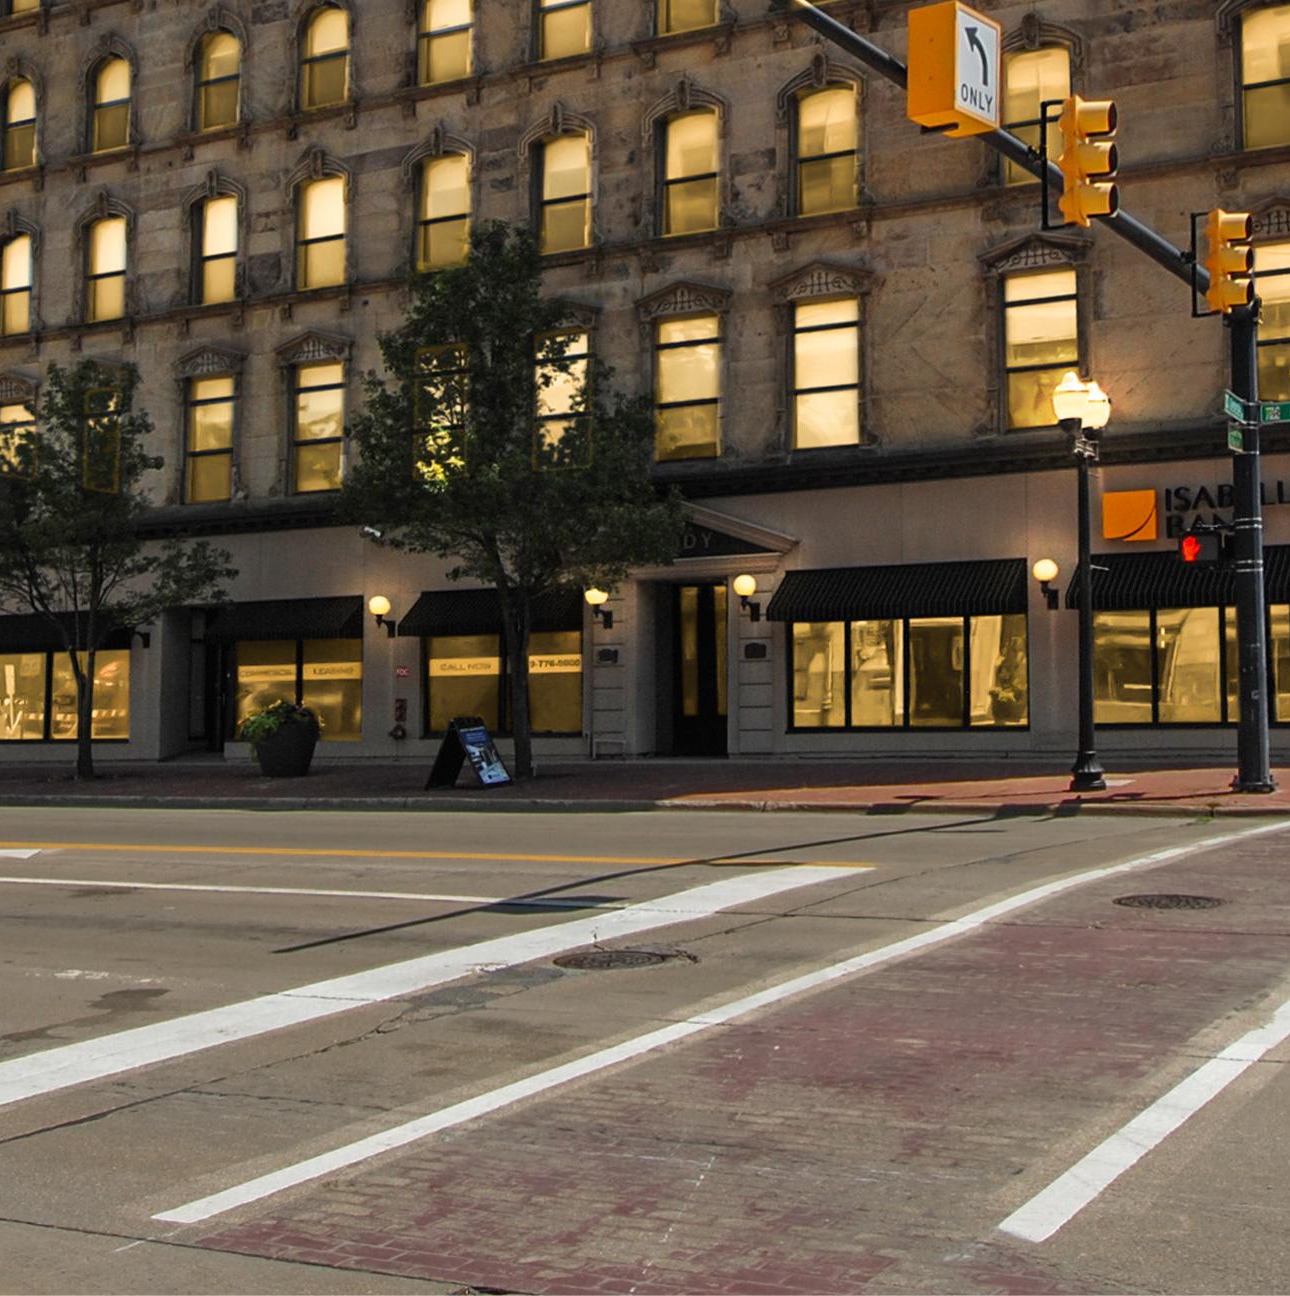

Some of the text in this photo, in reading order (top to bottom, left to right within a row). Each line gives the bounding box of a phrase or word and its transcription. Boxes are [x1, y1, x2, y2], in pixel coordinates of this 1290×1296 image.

[961, 83, 993, 113] ONLY
[1166, 514, 1235, 539] BAN
[440, 663, 465, 671] CALL
[468, 662, 491, 670] NOW
